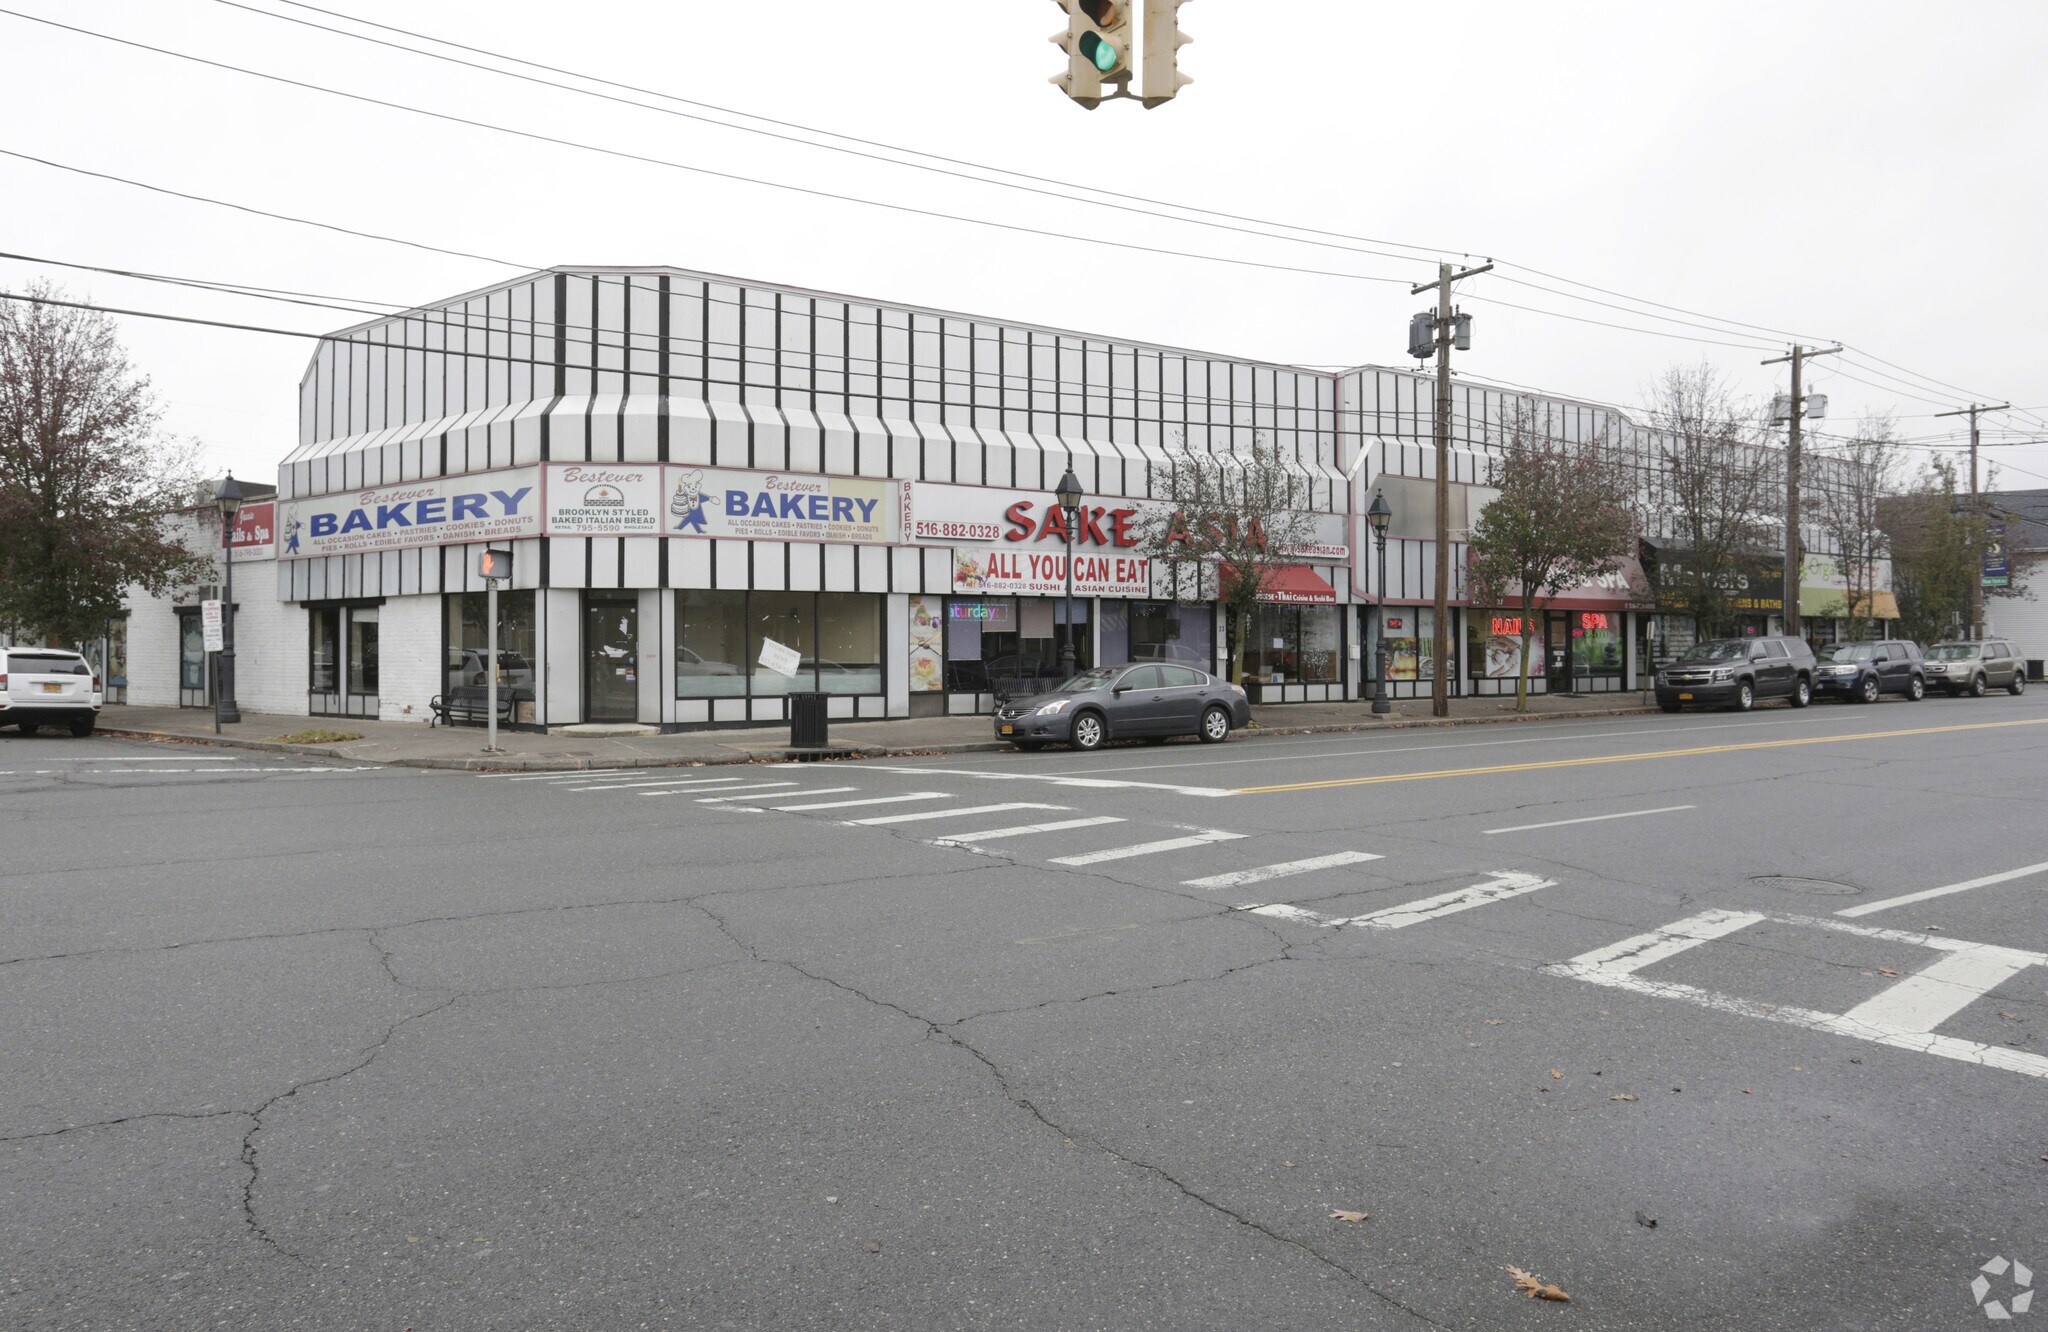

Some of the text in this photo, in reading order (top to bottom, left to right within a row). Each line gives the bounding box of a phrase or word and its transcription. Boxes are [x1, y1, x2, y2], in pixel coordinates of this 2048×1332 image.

[563, 466, 645, 483] Bestever
[764, 475, 822, 493] Bestever
[359, 487, 435, 506] Bestever
[310, 486, 534, 538] BAKERY
[558, 508, 649, 516] BROOKLYN STYLED
[725, 489, 879, 523] BAKERY
[903, 481, 912, 541] BAKERY
[551, 516, 656, 524] BAKED ITALIAN BREAD
[575, 524, 621, 532] 795-5590
[728, 518, 879, 533] ALL OCCASION CAKES PASTRIES COOKIES DONUTS
[1004, 500, 1140, 548] SAKE
[255, 524, 269, 544] Spa
[327, 534, 365, 544] OCCASION
[366, 530, 392, 540] CAKES
[399, 525, 438, 535] PASTRIES
[446, 521, 486, 532] COOKIES
[494, 515, 533, 527] DONUTS
[344, 542, 368, 551] ROLLS
[374, 537, 402, 547] EDIBLE
[404, 533, 435, 544] FAVORS
[442, 529, 476, 540] DANISH
[484, 525, 522, 536] BREADS
[734, 527, 873, 540] PIES ROLLS EDIBLE FAVORS DANISH BREADS
[986, 552, 1149, 584] ALL YOU CAN EAT
[1028, 583, 1061, 592] SUSHI
[1074, 585, 1105, 593] ASIAN
[1108, 586, 1148, 594] CUISINE
[1596, 570, 1630, 589] SPA
[1760, 599, 1783, 609] BATHS
[1581, 612, 1609, 629] SPA
